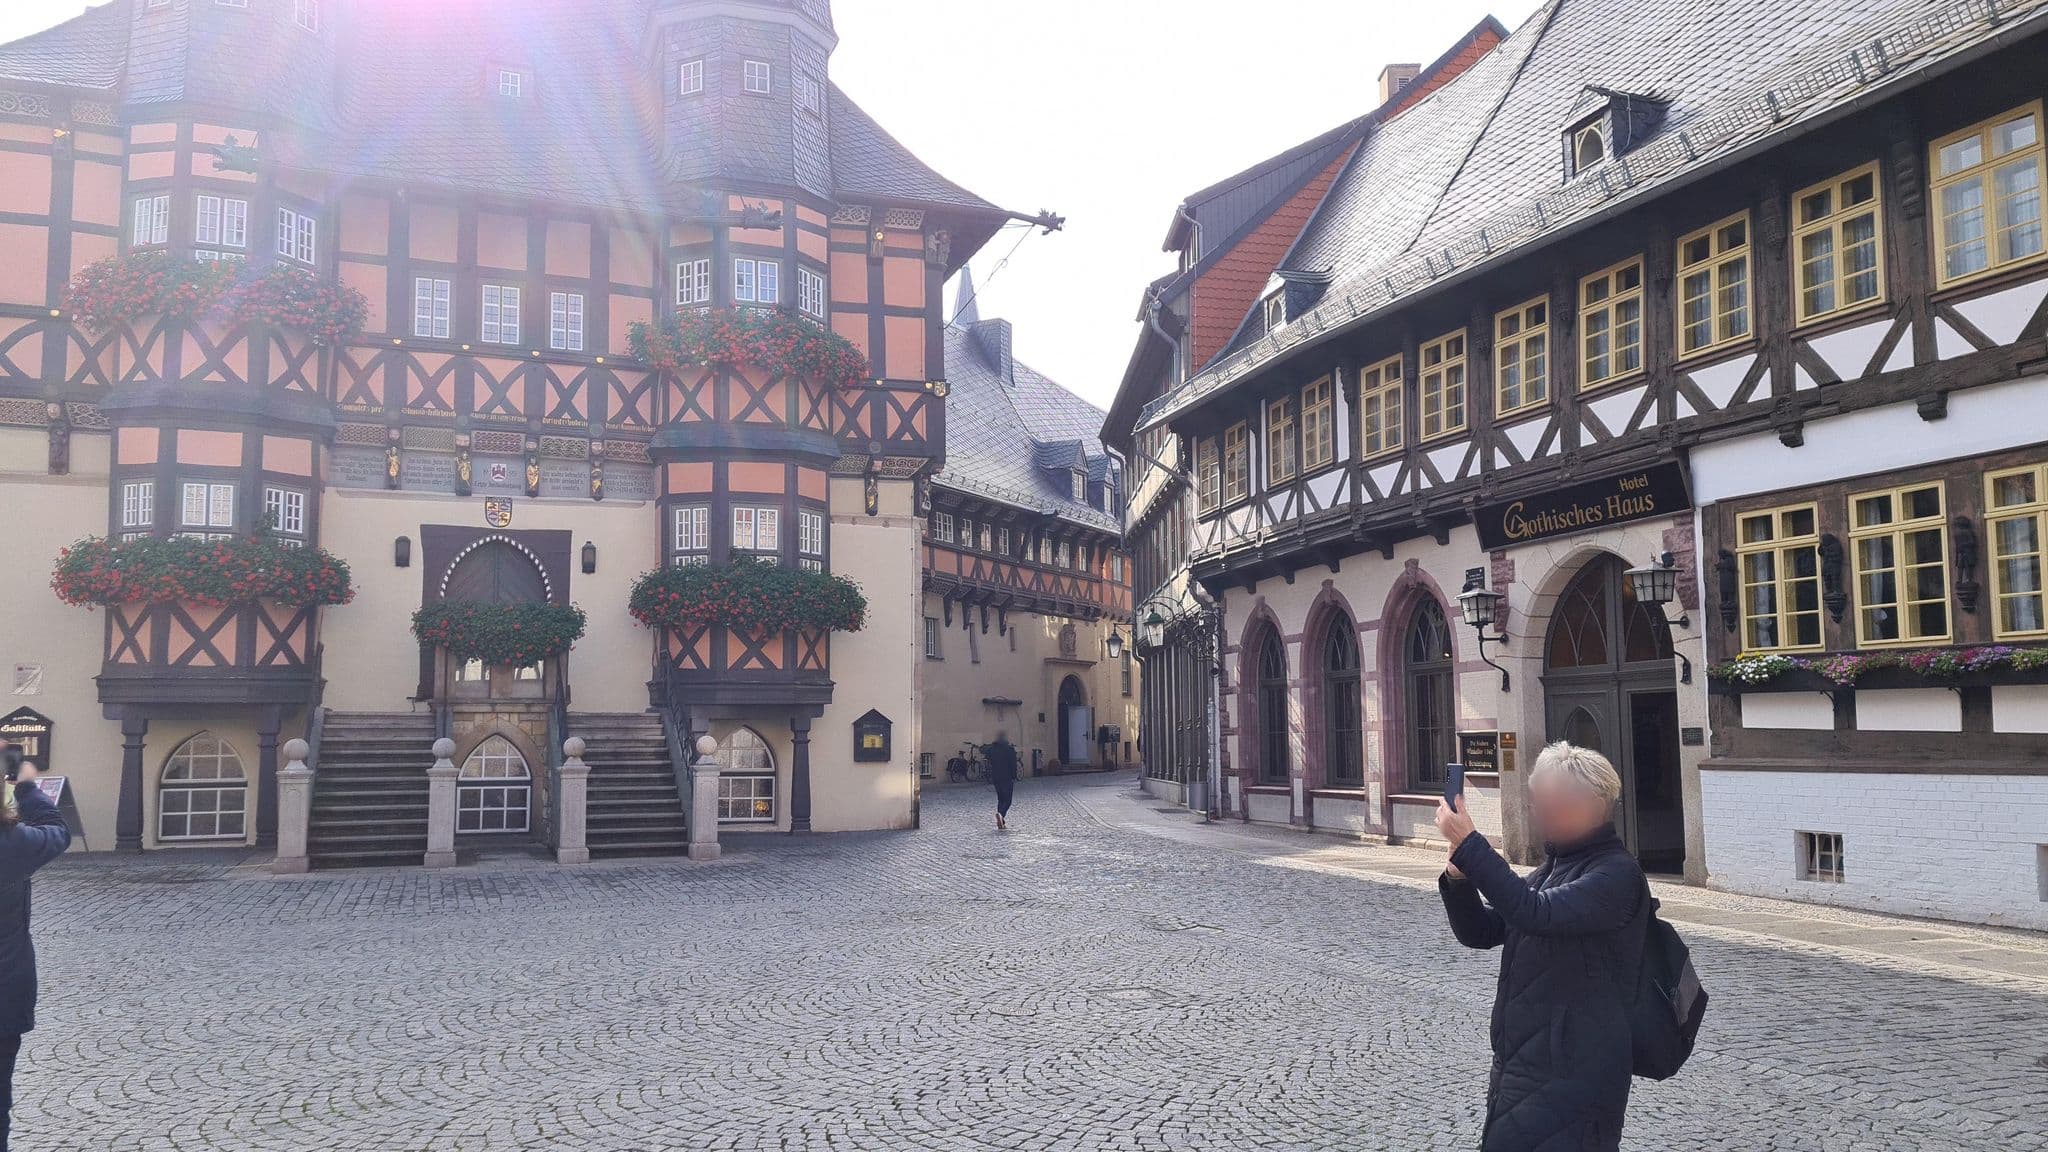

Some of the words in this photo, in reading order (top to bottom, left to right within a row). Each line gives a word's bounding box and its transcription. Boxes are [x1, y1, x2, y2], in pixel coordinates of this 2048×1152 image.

[1619, 473, 1649, 492] Hotel
[1503, 501, 1602, 539] Gothisches
[1605, 493, 1655, 520] Haus
